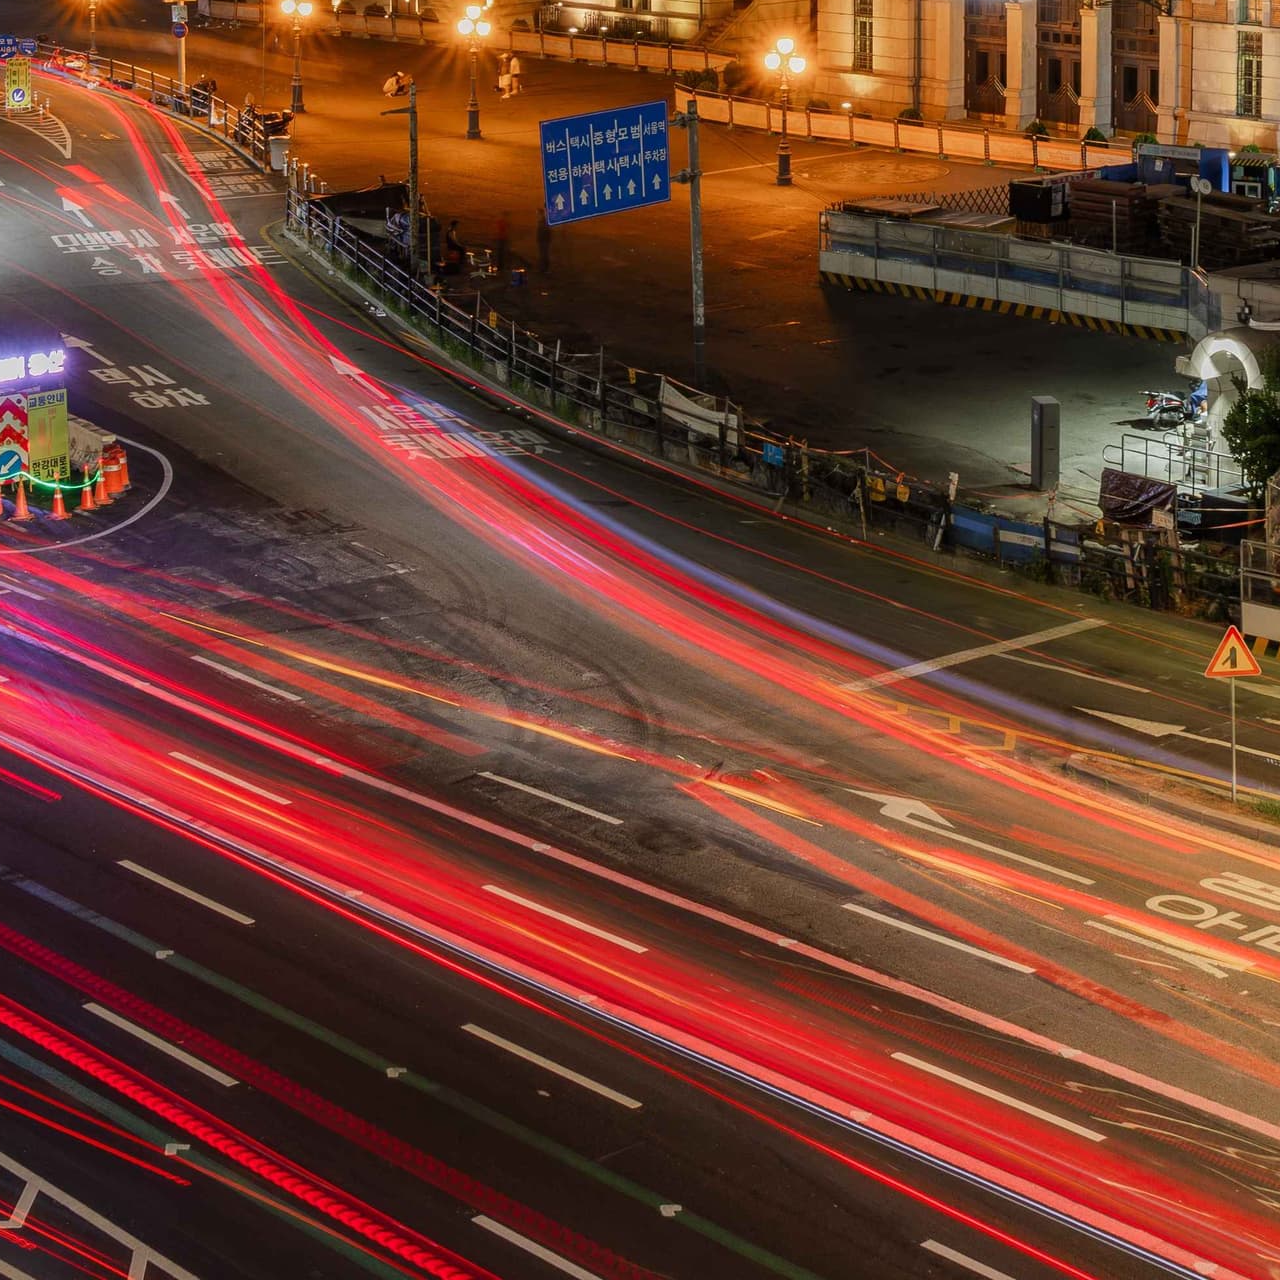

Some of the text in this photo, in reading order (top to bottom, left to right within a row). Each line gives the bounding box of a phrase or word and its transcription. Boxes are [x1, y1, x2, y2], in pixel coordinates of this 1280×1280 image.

[618, 124, 641, 141] 모범
[643, 120, 666, 136] 서울역
[545, 138, 567, 154] 버스
[569, 134, 590, 150] 택시
[593, 129, 617, 146] 중형
[619, 152, 642, 169] 택시
[644, 147, 667, 164] 주차장
[572, 162, 593, 178] 하차
[595, 157, 618, 174] 택시
[547, 167, 569, 184] 전용
[50, 227, 161, 255] 모범택시
[90, 253, 167, 277] 승차
[88, 365, 178, 388] 택시
[28, 391, 65, 408] 교통안내
[127, 387, 212, 410] 하차
